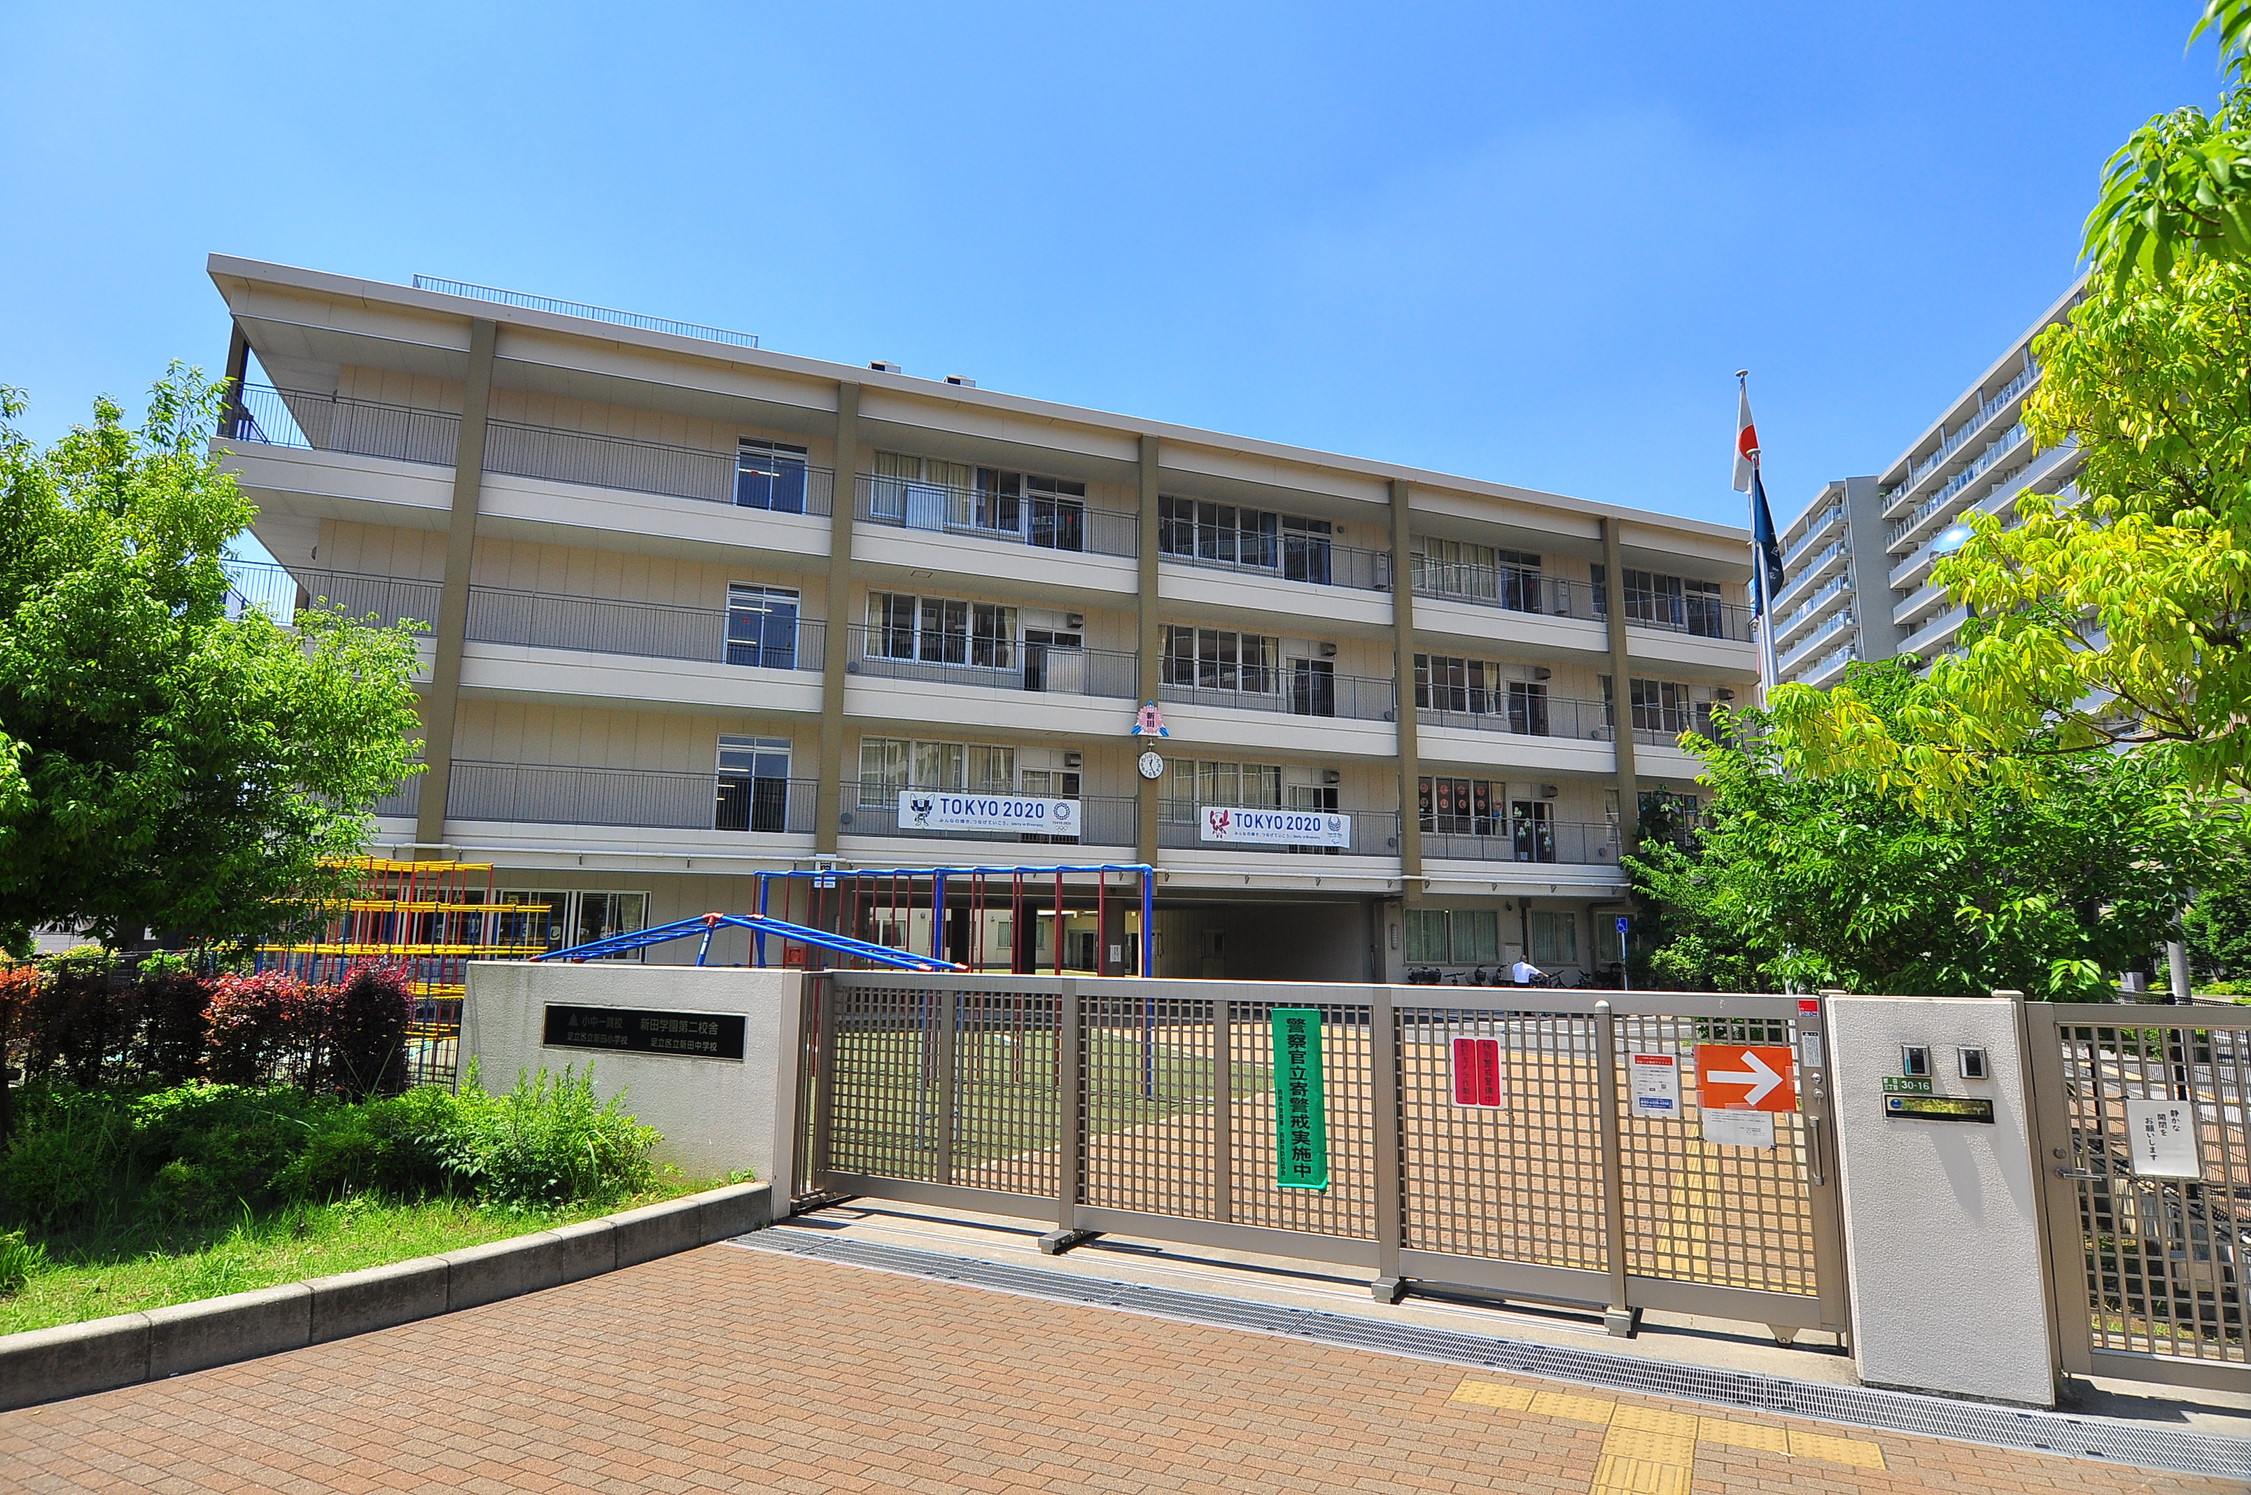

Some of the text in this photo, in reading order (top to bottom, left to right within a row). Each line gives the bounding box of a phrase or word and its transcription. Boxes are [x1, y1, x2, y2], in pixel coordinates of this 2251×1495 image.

[1146, 712, 1155, 728] 新田
[940, 798, 1045, 819] TOKYO 2020
[1234, 813, 1321, 832] TOKYO 2020
[581, 1015, 719, 1036] 小中一貫校 新田学園第二校舎
[567, 1031, 718, 1052] 足立区立新田小学校 足立区立新田中学校
[1901, 1080, 1930, 1091] 30-16
[1286, 1017, 1313, 1179] 警察官立寄警戒実施中
[2157, 1113, 2168, 1137] 開閉を
[2170, 1109, 2181, 1132] 静かな
[2145, 1117, 2158, 1161] お願いします
